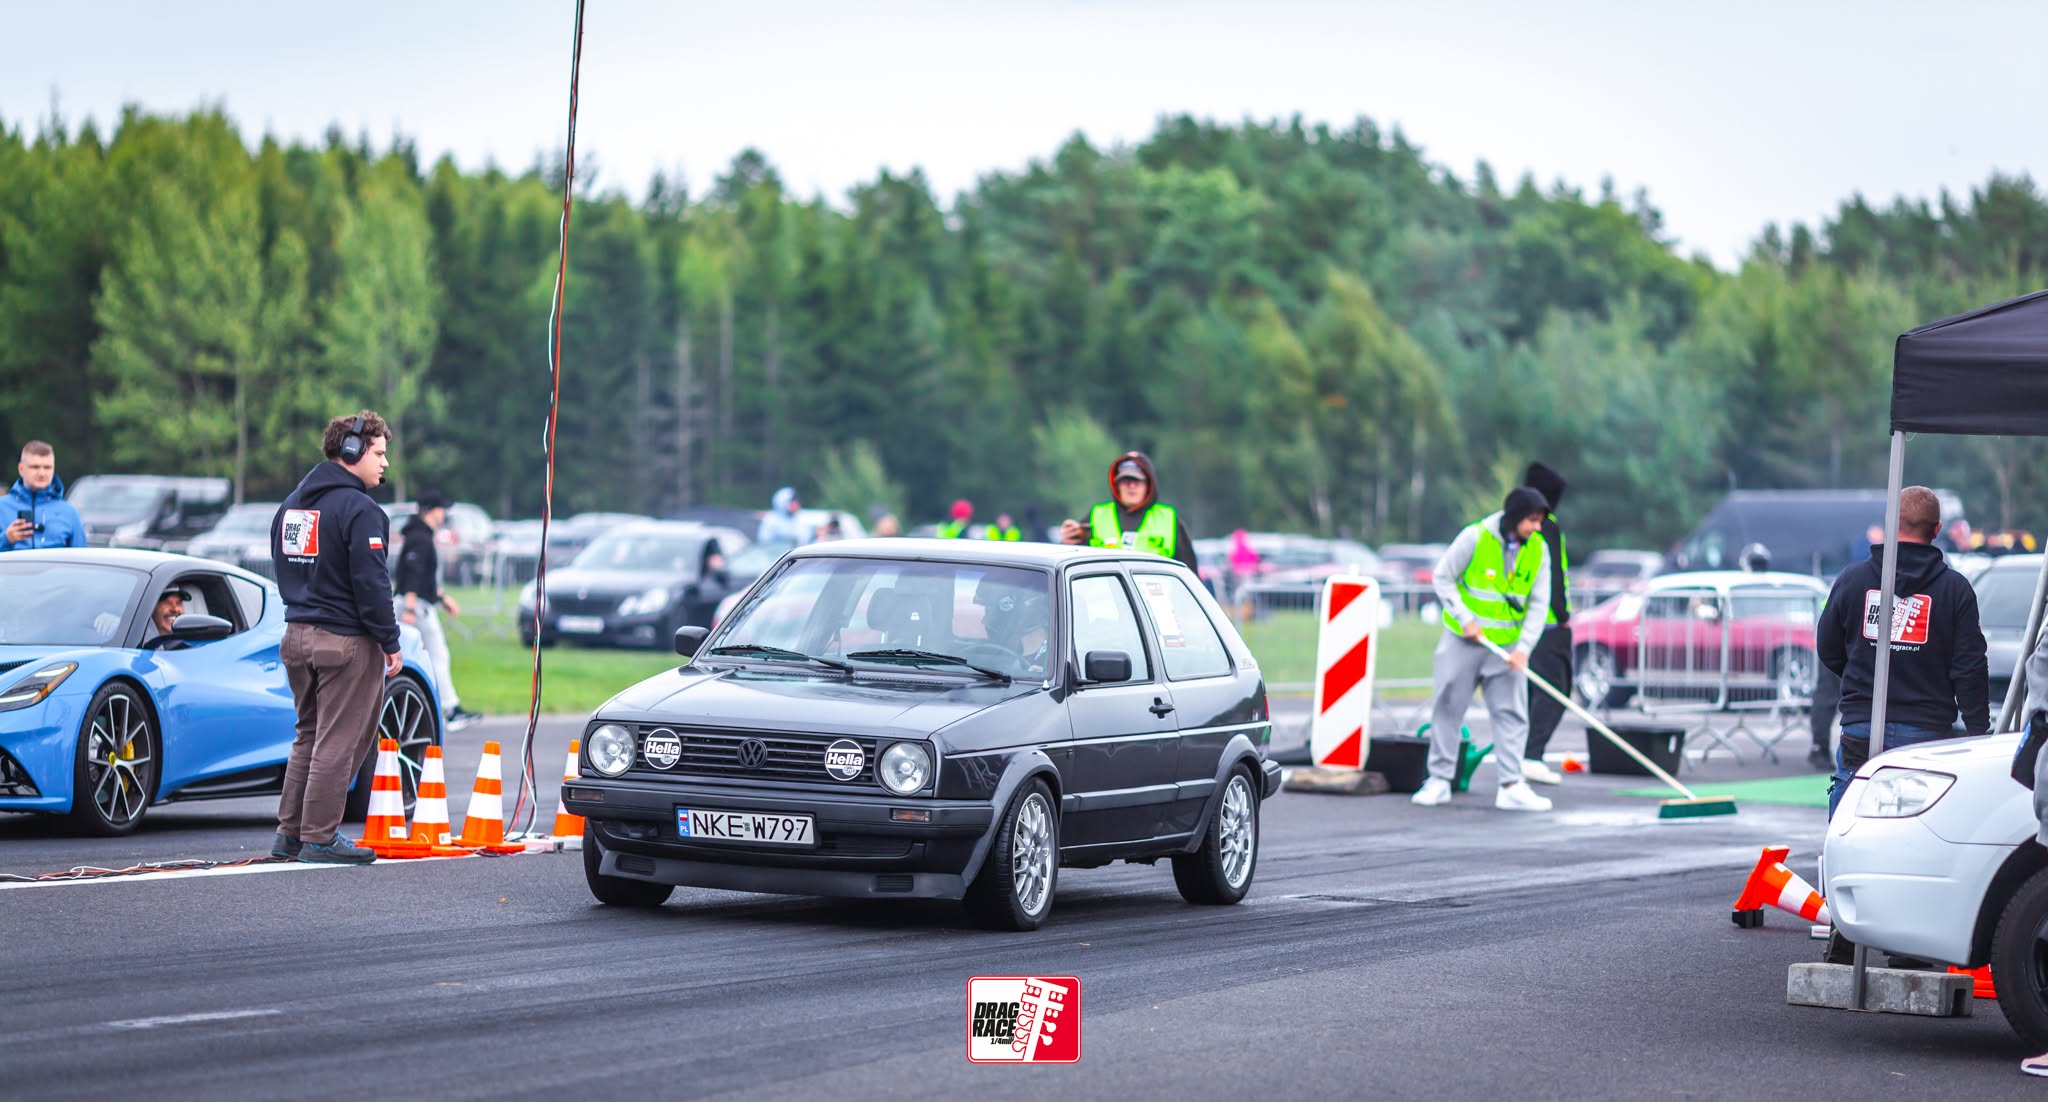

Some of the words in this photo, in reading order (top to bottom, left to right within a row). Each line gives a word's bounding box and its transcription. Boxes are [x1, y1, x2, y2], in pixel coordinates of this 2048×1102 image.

[285, 523, 302, 532] DRAG
[284, 532, 298, 542] RACE
[646, 741, 680, 755] Hella
[827, 752, 863, 766] Hella
[680, 825, 689, 833] PL
[692, 813, 743, 838] NKE
[752, 816, 809, 841] W797
